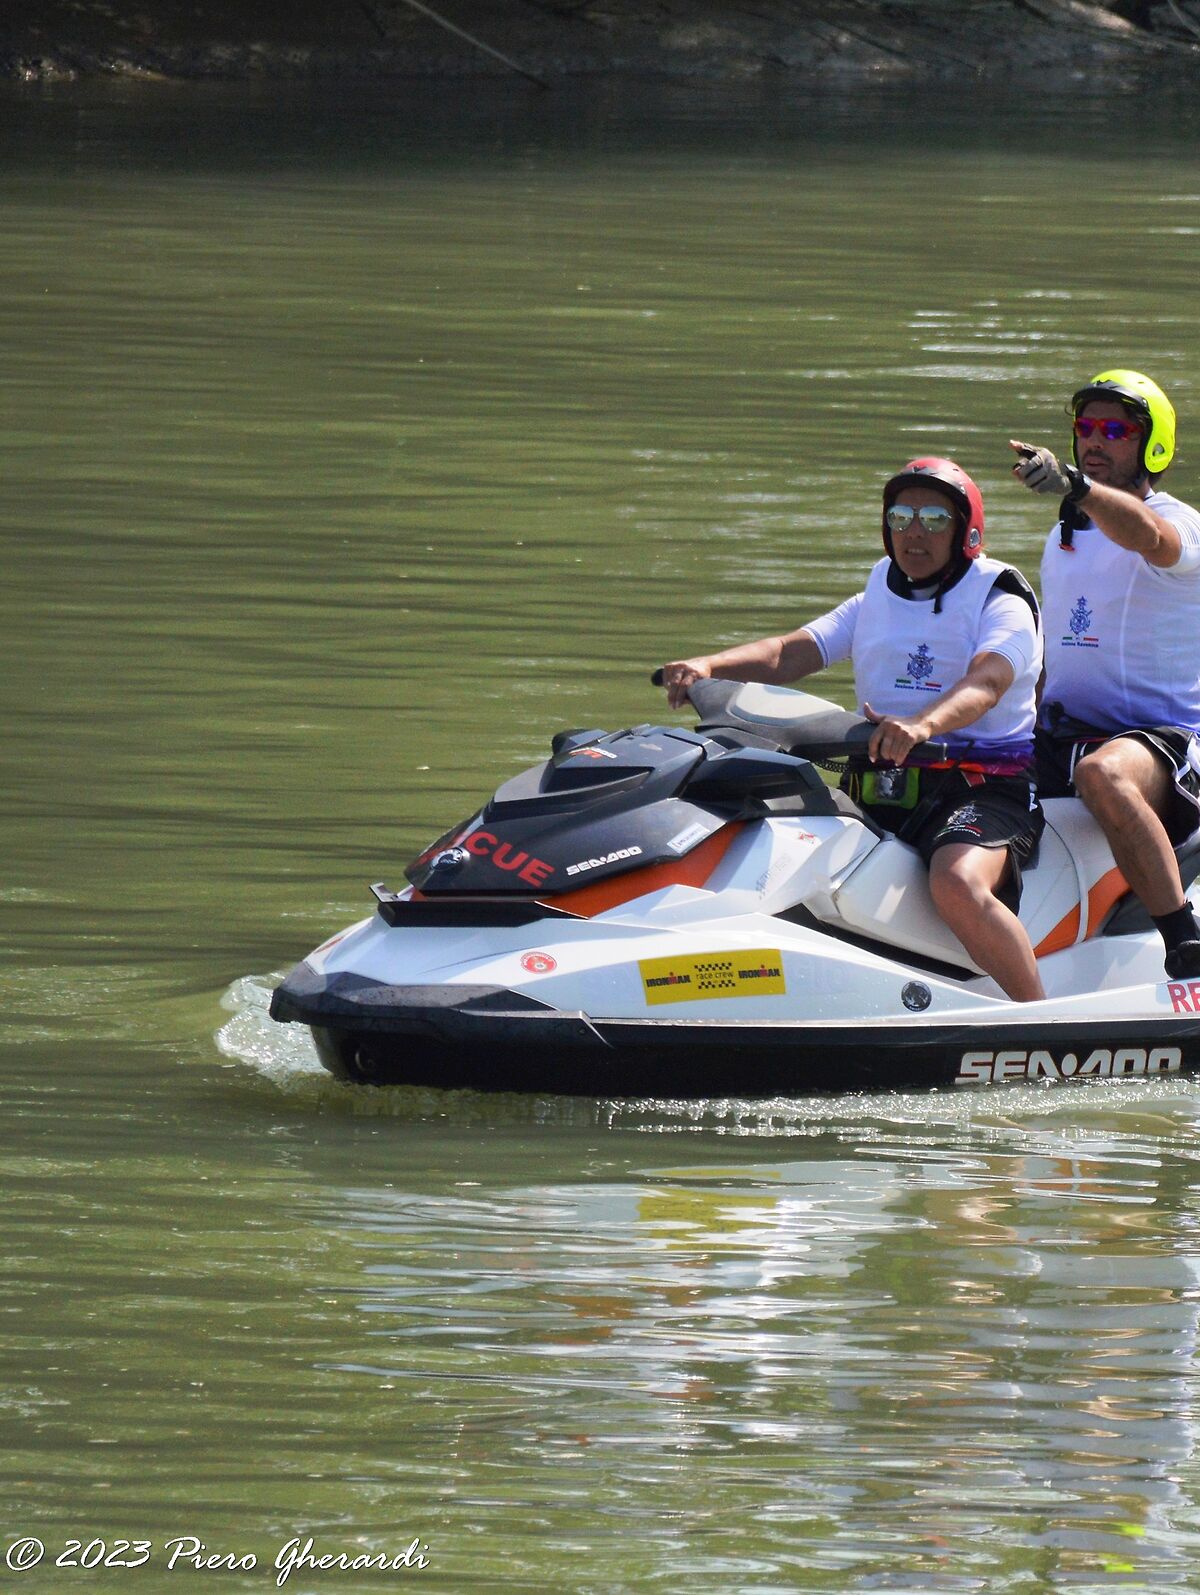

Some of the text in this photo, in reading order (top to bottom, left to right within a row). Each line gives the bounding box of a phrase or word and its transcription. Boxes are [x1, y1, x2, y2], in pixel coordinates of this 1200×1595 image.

[646, 972, 691, 987] IRONMAN
[715, 971, 734, 979] crew
[738, 964, 780, 979] IRONMAN
